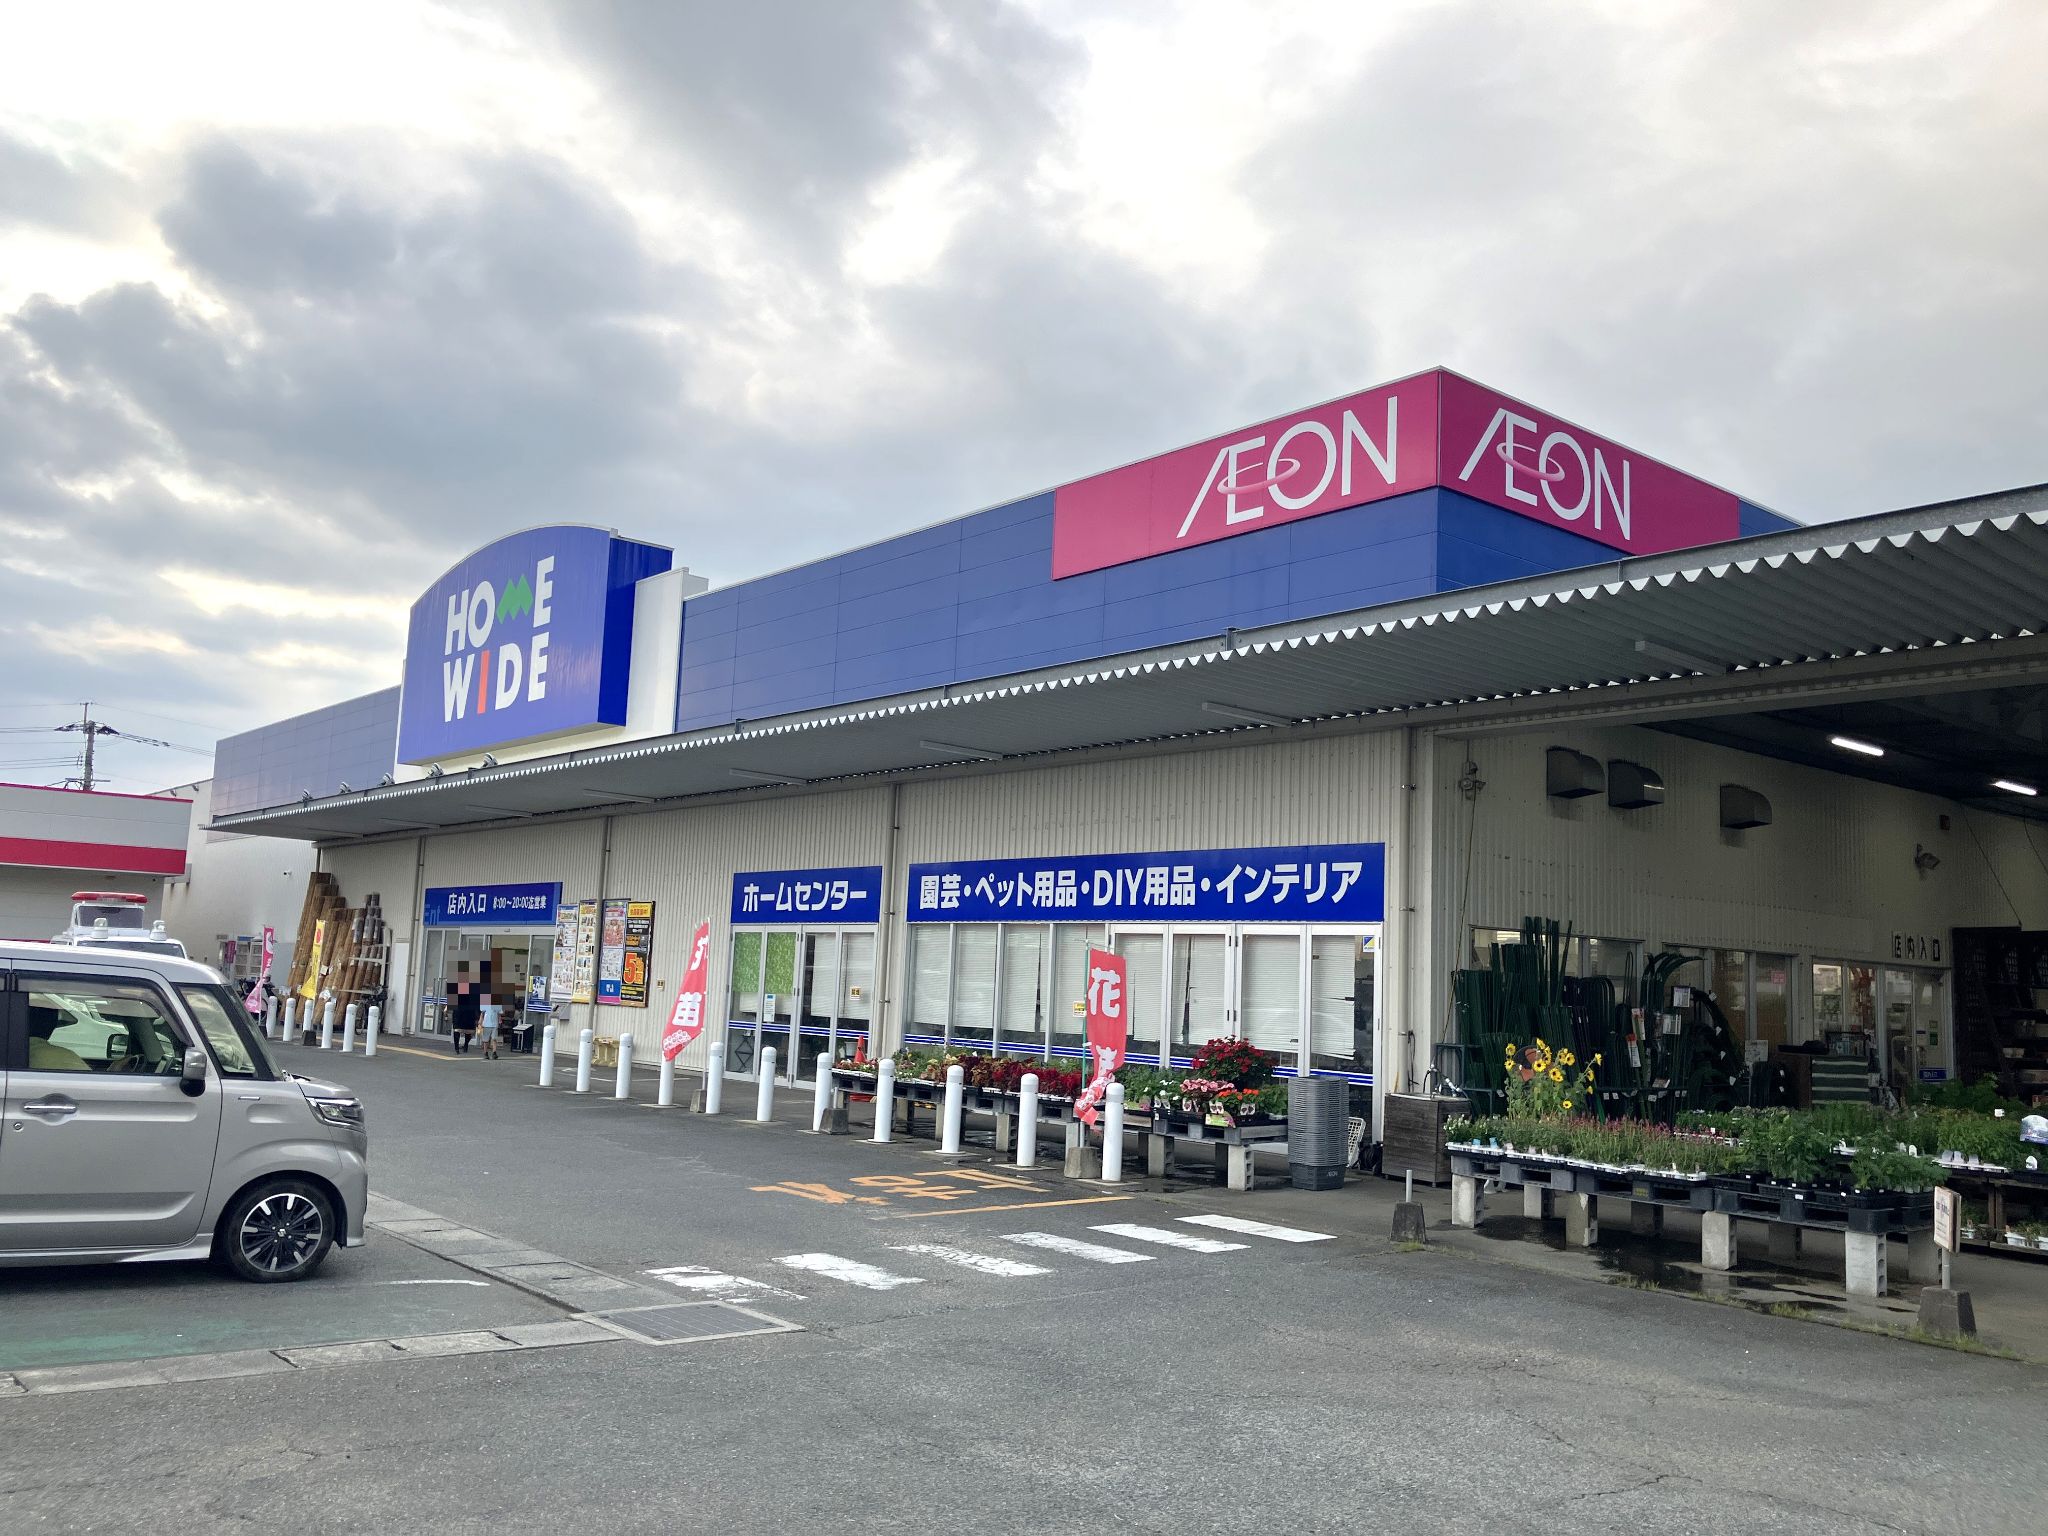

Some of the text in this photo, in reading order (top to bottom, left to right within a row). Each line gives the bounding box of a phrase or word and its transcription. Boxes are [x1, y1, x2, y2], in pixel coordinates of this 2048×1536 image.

[743, 880, 867, 913] ホームセンター
[920, 861, 1363, 910] 園芸・ペット用品・DIY用品・インテリア
[447, 893, 486, 915] 店内入口
